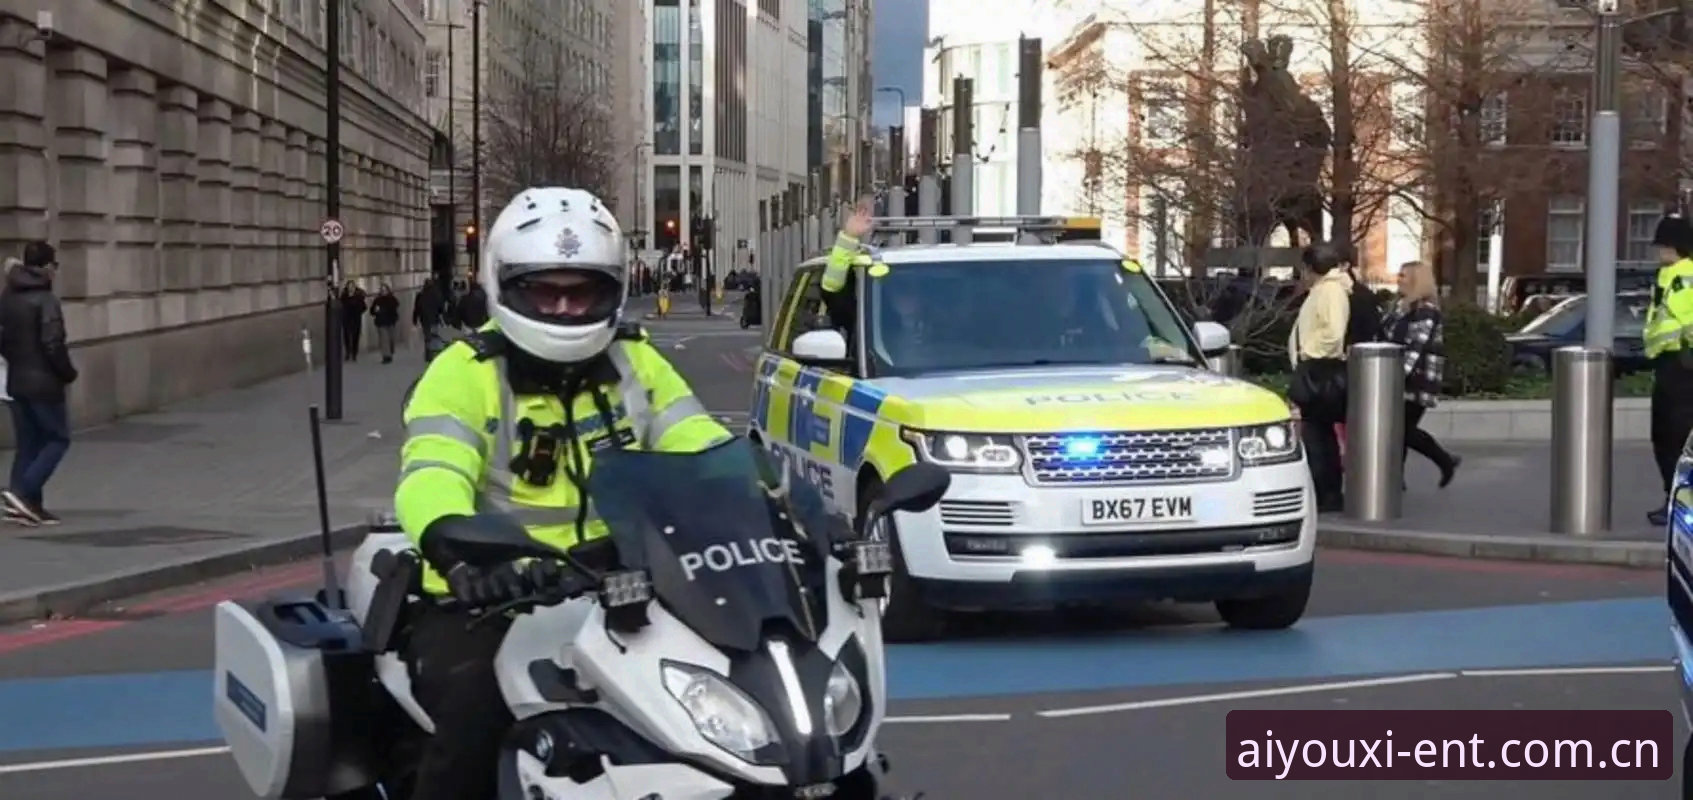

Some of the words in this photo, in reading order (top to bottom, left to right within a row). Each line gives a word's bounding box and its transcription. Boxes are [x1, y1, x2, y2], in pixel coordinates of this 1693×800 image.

[322, 224, 342, 238] 20
[1025, 391, 1197, 406] POLICE
[1091, 498, 1146, 520] BX67
[1151, 496, 1192, 517] EVM
[678, 537, 806, 582] POLICE
